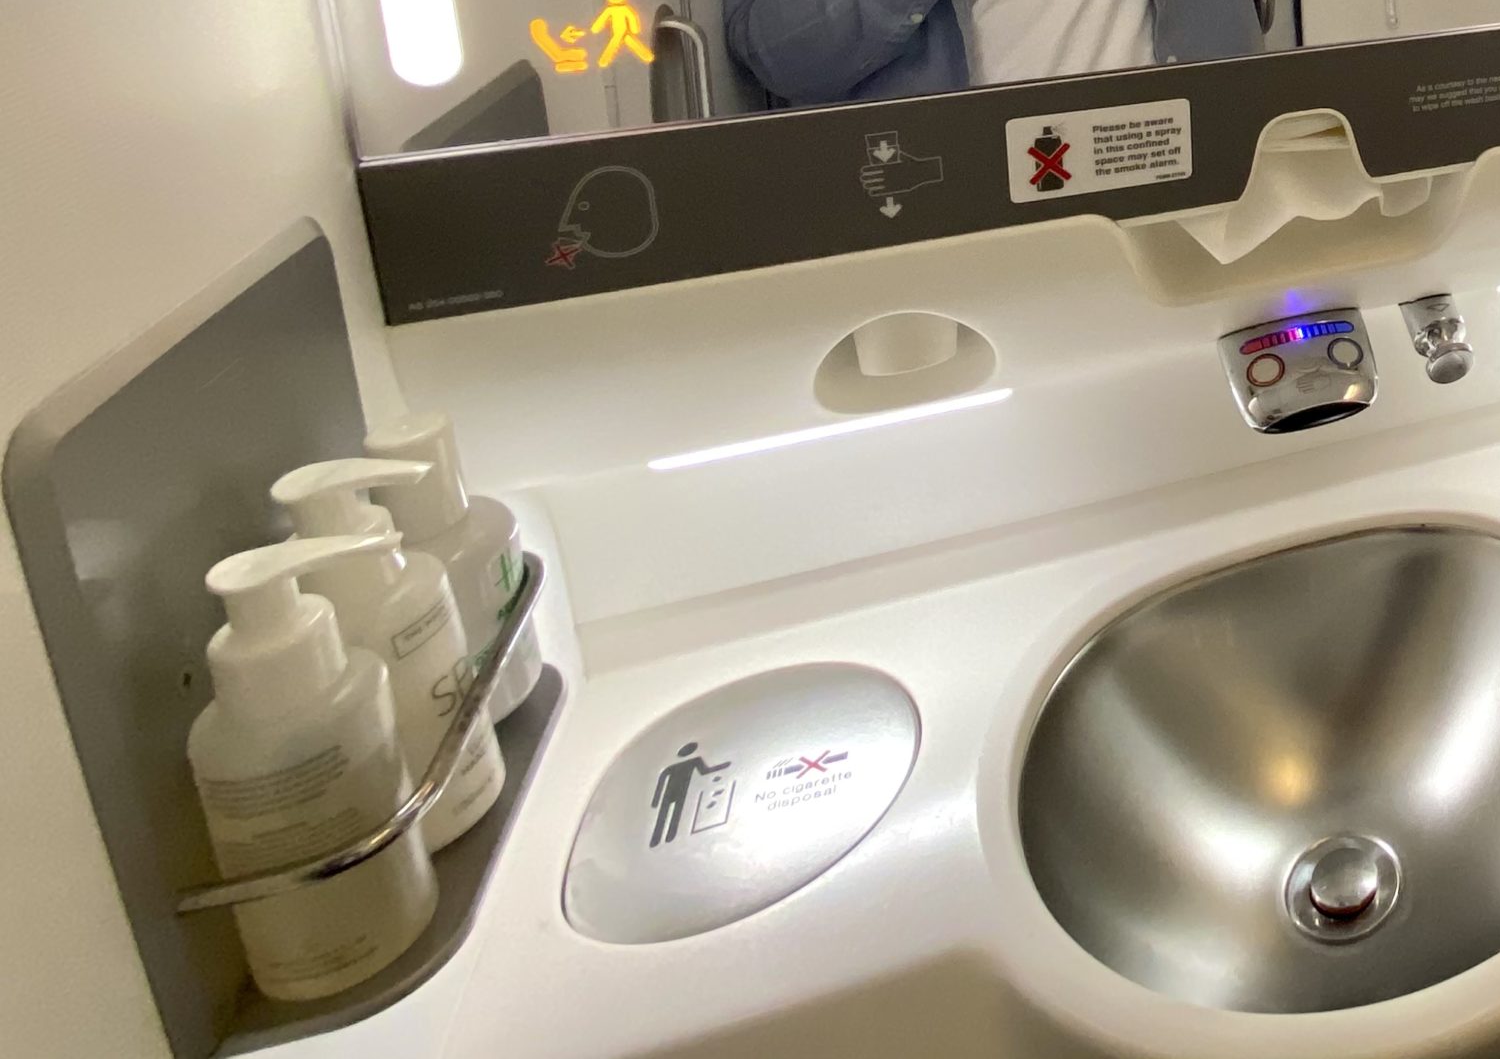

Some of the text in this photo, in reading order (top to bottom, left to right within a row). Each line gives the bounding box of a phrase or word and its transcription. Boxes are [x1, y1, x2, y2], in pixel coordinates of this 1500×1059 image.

[1092, 118, 1174, 133] Please be aware
[1094, 135, 1113, 144] that
[1115, 132, 1143, 141] using
[1155, 127, 1181, 137] spray
[1094, 138, 1170, 155] in this confined
[1095, 147, 1181, 166] space may set off
[1095, 159, 1179, 176] the smoke alarm.
[754, 771, 852, 803] No cigarette
[767, 784, 837, 812] disposal
